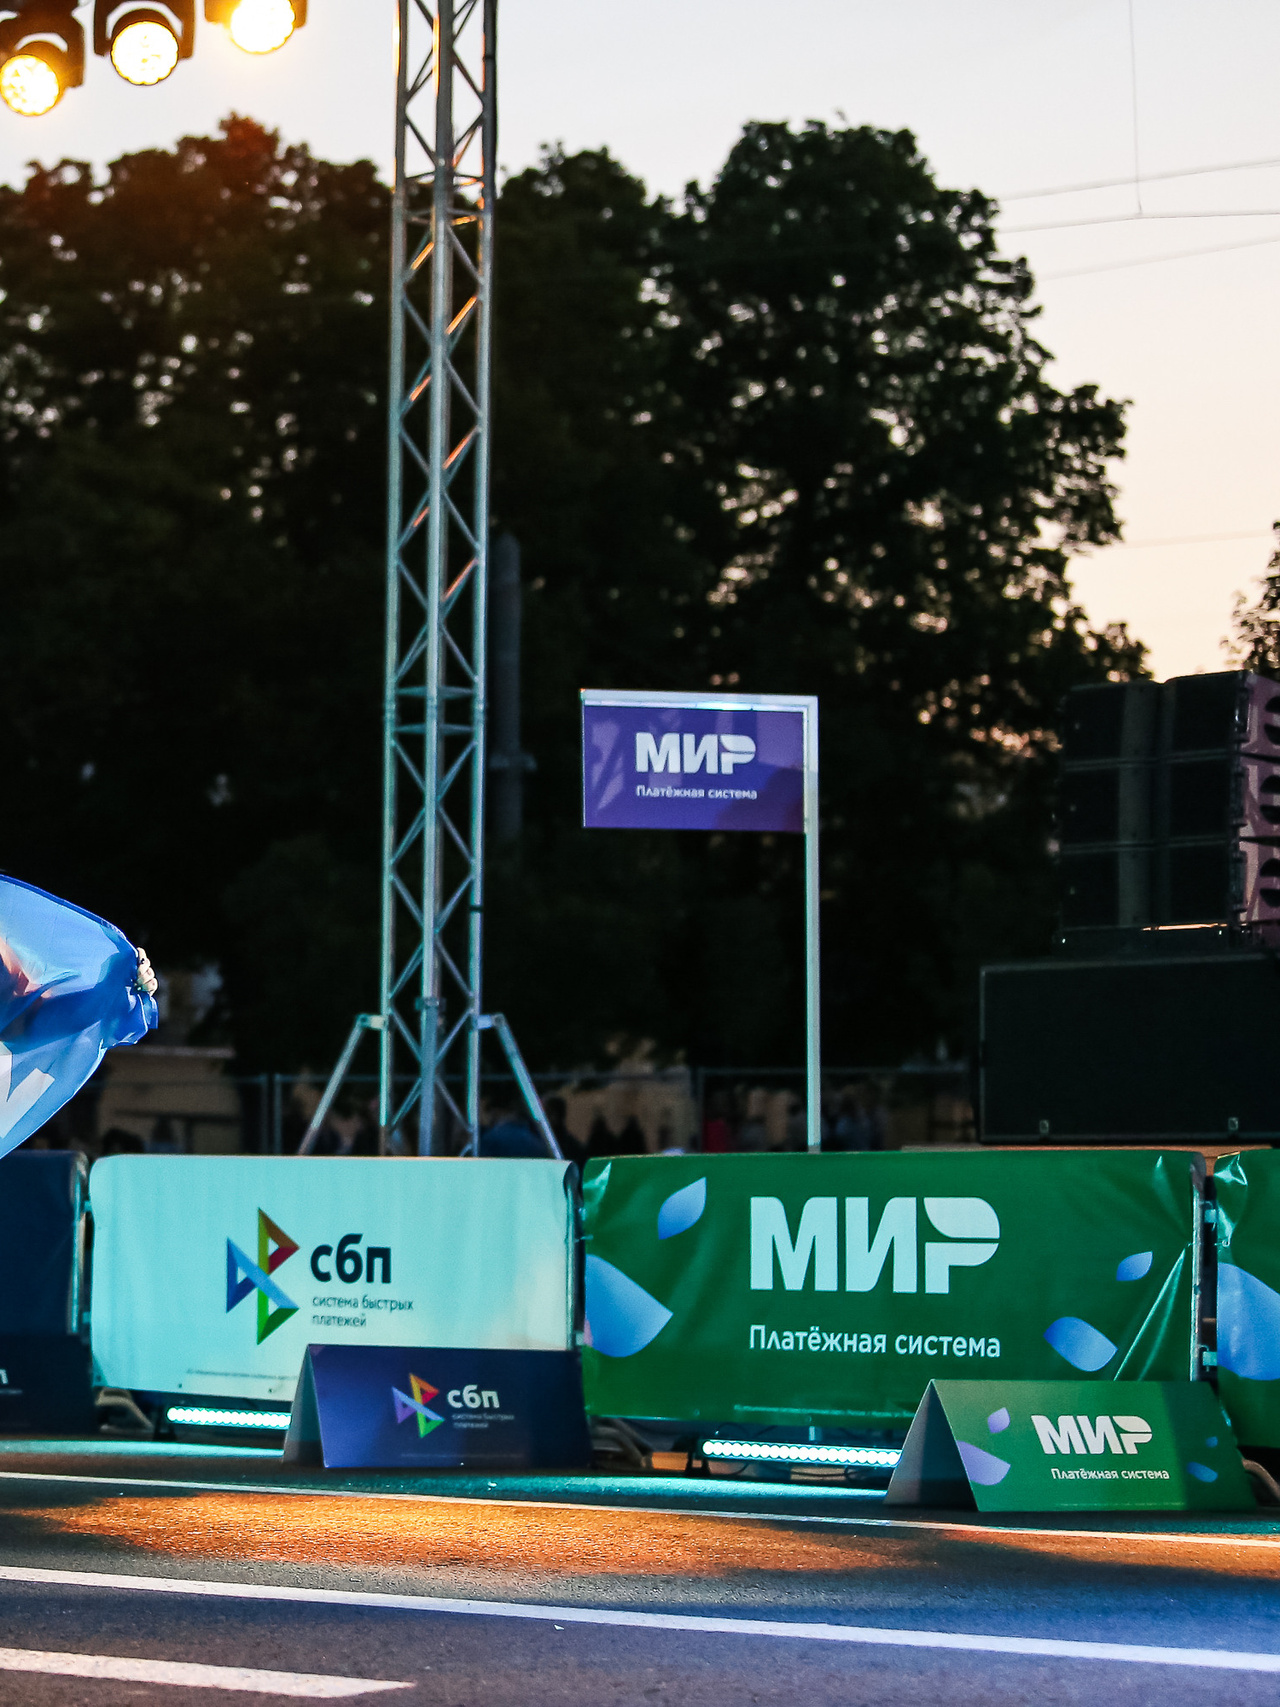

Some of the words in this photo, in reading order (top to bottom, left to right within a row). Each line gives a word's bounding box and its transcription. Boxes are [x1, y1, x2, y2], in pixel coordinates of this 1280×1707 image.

[635, 731, 757, 775] МИР
[636, 784, 705, 799] Платёжная
[707, 788, 758, 800] система
[309, 1232, 392, 1284] сбп
[749, 1196, 1001, 1294] МИР
[312, 1296, 359, 1309] система
[362, 1294, 414, 1313] быстрых
[312, 1312, 367, 1327] платежей
[749, 1324, 888, 1354] Платёжная
[894, 1333, 1001, 1358] система
[446, 1384, 500, 1409] сбп
[1030, 1414, 1153, 1455] МИР
[1050, 1468, 1119, 1480] Платёжная
[1121, 1469, 1170, 1480] система
